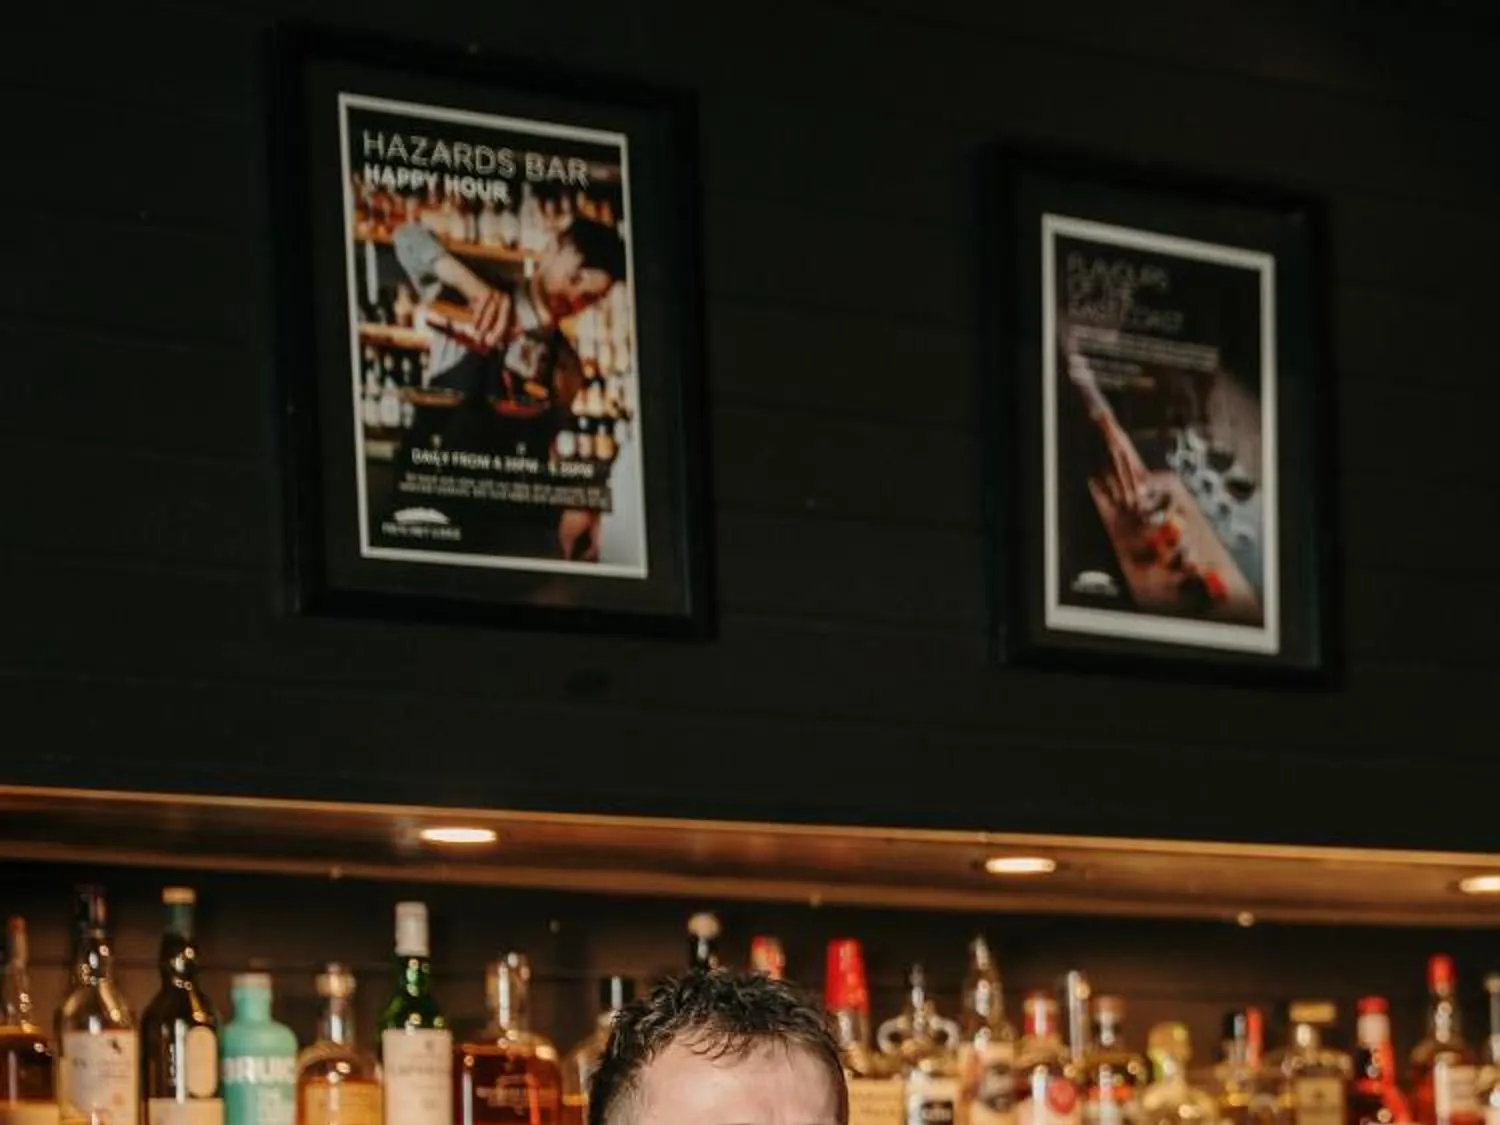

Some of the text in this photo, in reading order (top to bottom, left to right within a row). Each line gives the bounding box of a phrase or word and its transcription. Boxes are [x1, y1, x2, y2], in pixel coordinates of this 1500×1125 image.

[364, 129, 590, 189] HAZARDS BAR
[364, 163, 512, 205] HAPPY HOUR
